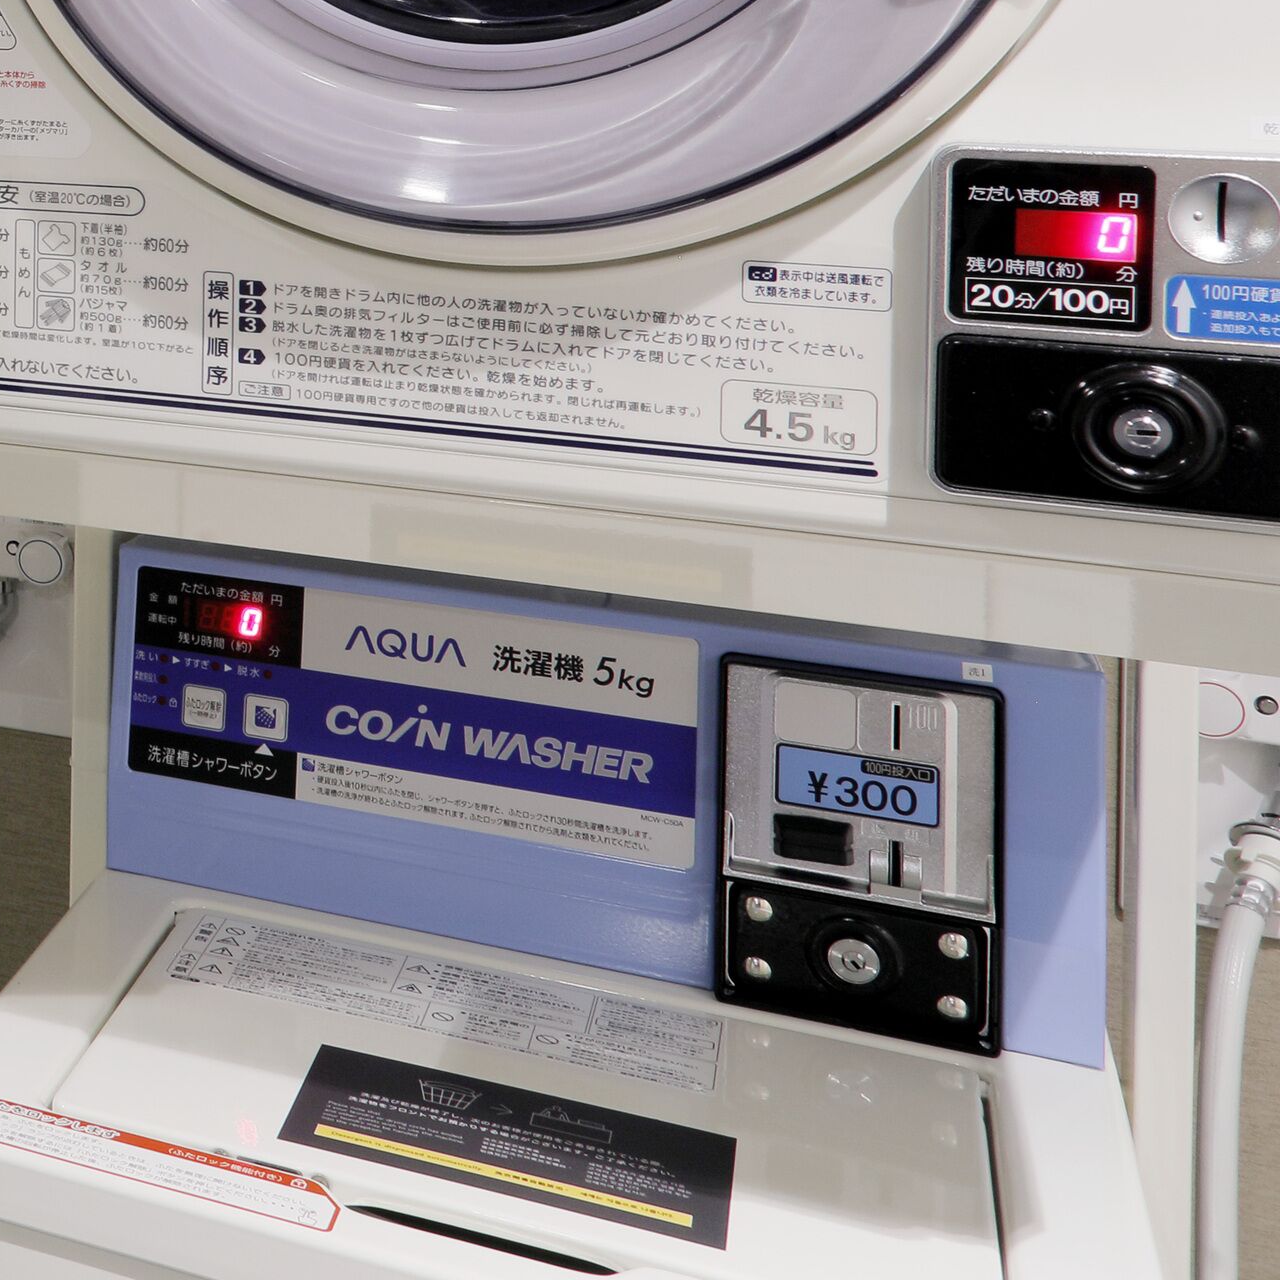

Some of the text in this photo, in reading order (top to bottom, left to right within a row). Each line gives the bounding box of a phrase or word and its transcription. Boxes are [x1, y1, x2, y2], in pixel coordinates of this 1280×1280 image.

[968, 185, 1139, 209] ただいまの金額 円
[143, 237, 190, 254] 約60分
[1096, 216, 1131, 253] 0
[143, 276, 189, 292] 約60分
[779, 270, 885, 288] 表示中は送風運転で
[1116, 266, 1138, 281] 分
[79, 298, 128, 311] パジャマ
[754, 286, 878, 304] 衣類を冷ましています。
[970, 283, 1129, 315] 20分/100円
[273, 282, 796, 334] ドアを開きドラム内に他の人の洗濯物が入っていないか確かめてください。
[142, 314, 189, 331] 約60分
[205, 280, 230, 386] 操作順序
[274, 352, 604, 394] 100円硬貨を入れてください。乾燥を始めます。
[244, 383, 284, 398] ご注意
[752, 388, 844, 411] 乾燥容量
[181, 582, 283, 607] ただいまの金額 円
[148, 613, 177, 625] 運転中
[240, 607, 262, 637] 0
[269, 646, 281, 658] 分
[345, 625, 467, 668] AQUA
[184, 657, 210, 670] すすぎ
[237, 665, 260, 678] 脱水
[492, 645, 655, 699] 洗濯機 5kg
[148, 744, 278, 781] 洗濯槽シャワーボタン
[464, 726, 654, 784] WASHER
[317, 761, 403, 785] 洗濯槽シャワーボタン
[865, 761, 931, 781] 100円投入口
[807, 770, 918, 816] ¥300
